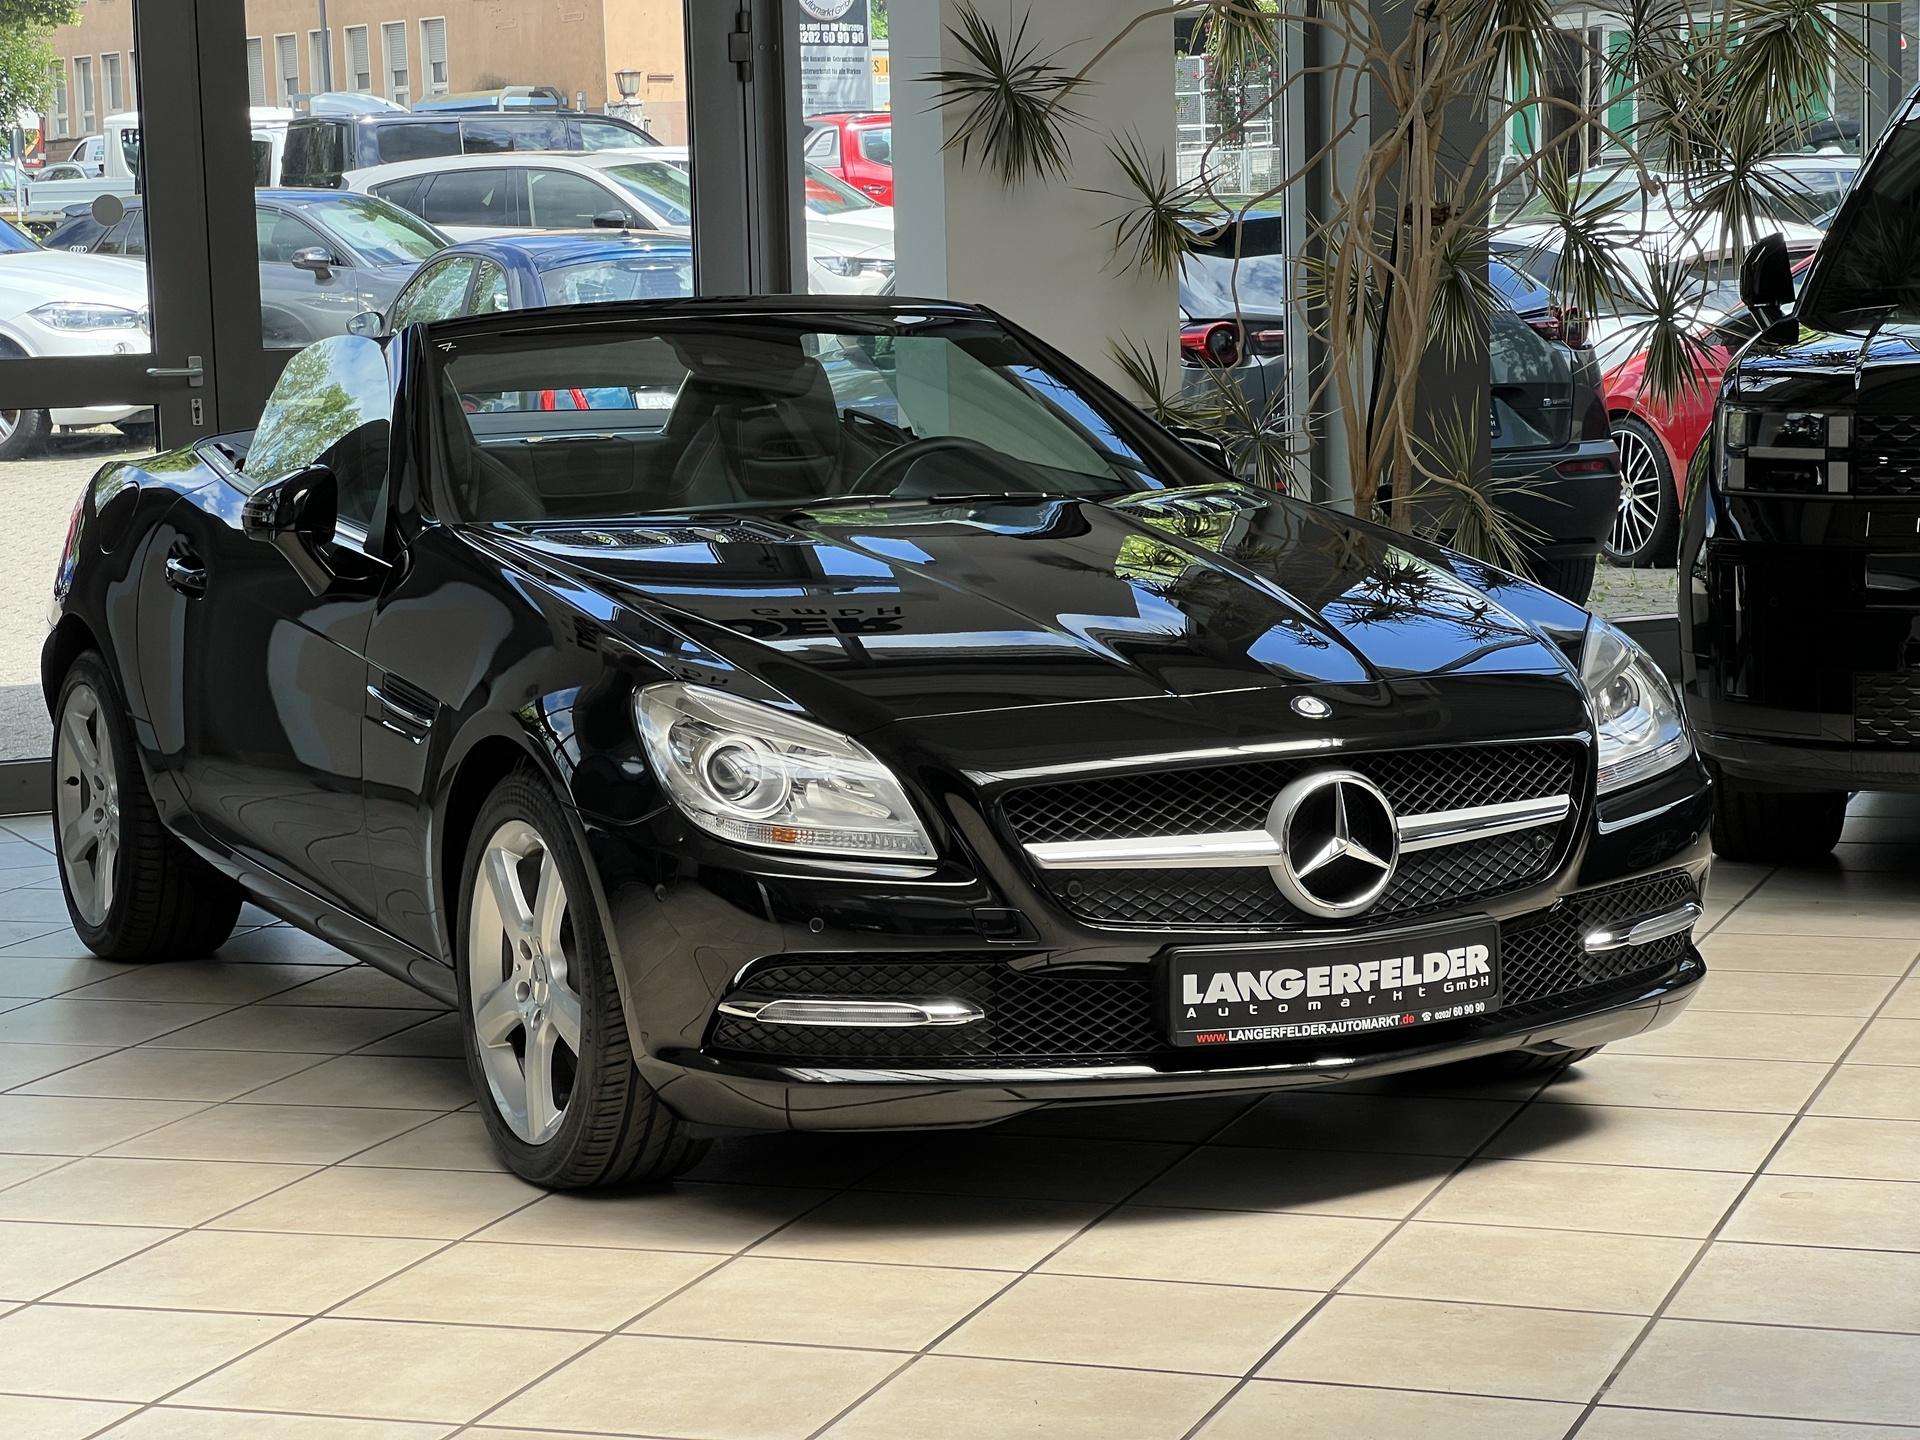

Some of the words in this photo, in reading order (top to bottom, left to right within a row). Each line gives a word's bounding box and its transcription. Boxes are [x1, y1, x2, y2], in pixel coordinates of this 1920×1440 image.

[823, 31, 835, 43] 60
[852, 31, 864, 44] 90
[1183, 944, 1490, 1005] LANGERFELDER
[1443, 975, 1489, 993] GmbH
[1196, 1013, 1415, 1043] www.LANGERFELDER-AUTOMARKT.de
[1464, 1004, 1474, 1015] 90
[1475, 1002, 1486, 1013] 90
